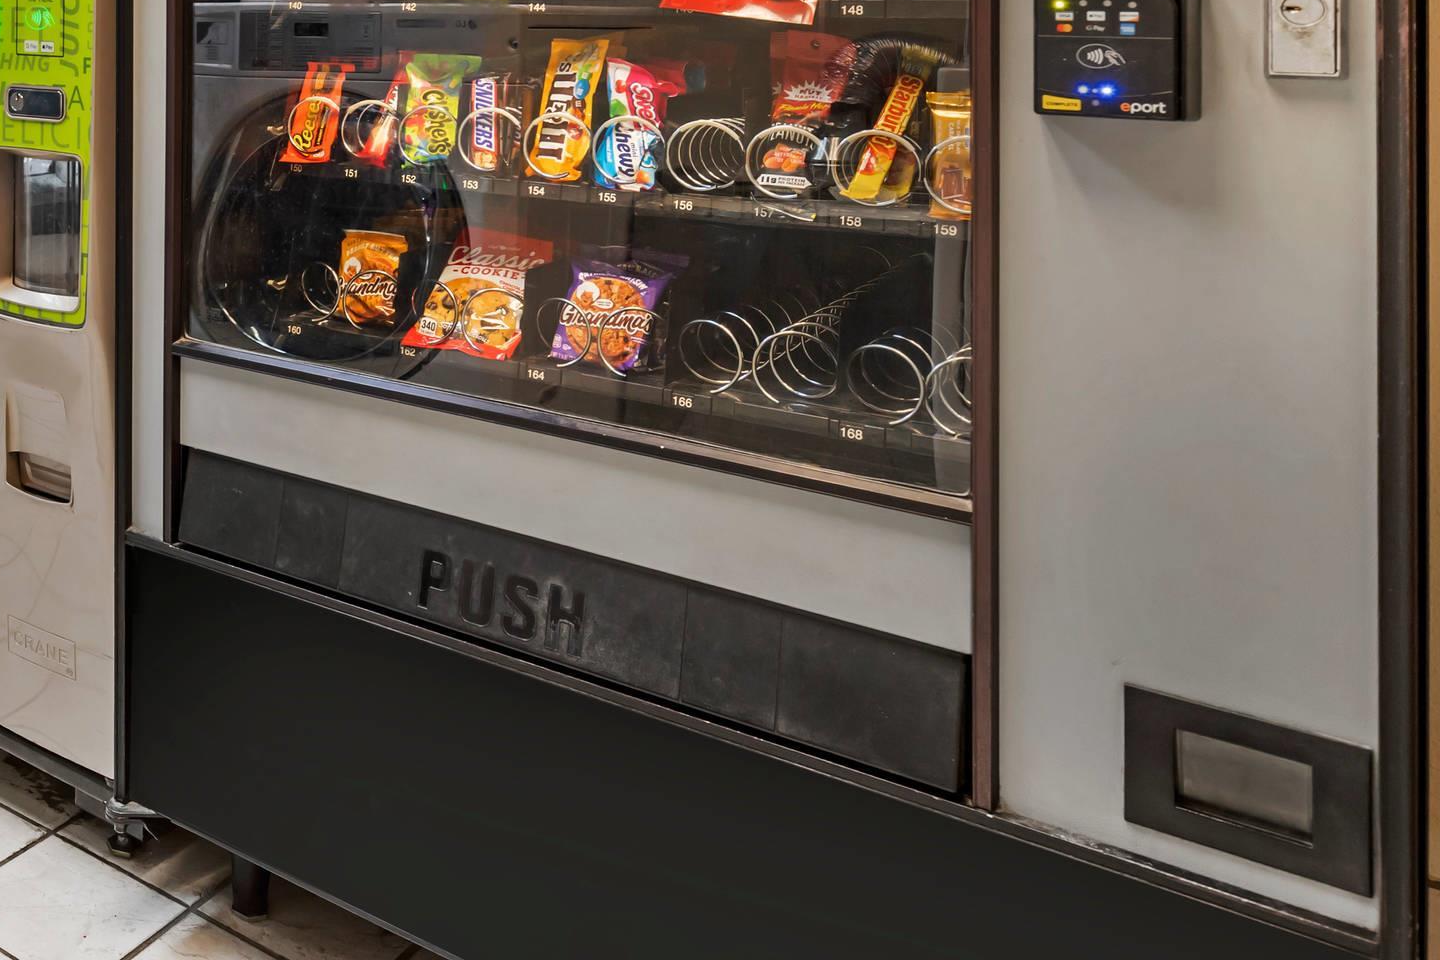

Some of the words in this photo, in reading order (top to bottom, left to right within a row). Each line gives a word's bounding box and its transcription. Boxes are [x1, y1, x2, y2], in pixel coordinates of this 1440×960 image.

[288, 1, 302, 10] 140
[401, 2, 416, 12] 142
[529, 3, 545, 13] 144
[841, 5, 863, 16] 148
[1120, 102, 1167, 115] eport
[344, 169, 358, 178] 151
[401, 175, 416, 184] 152
[462, 180, 478, 190] 153
[528, 186, 545, 196] 154
[598, 192, 616, 203] 155
[674, 199, 693, 211] 156
[840, 215, 862, 227] 158
[934, 224, 958, 236] 159
[448, 246, 544, 270] Classic
[287, 326, 301, 335] 160
[421, 319, 436, 331] 340
[400, 347, 416, 357] 162
[528, 369, 545, 381] 164
[672, 396, 692, 408] 166
[840, 427, 863, 440] 168
[417, 548, 586, 659] PUSH
[13, 629, 68, 665] CRANE
